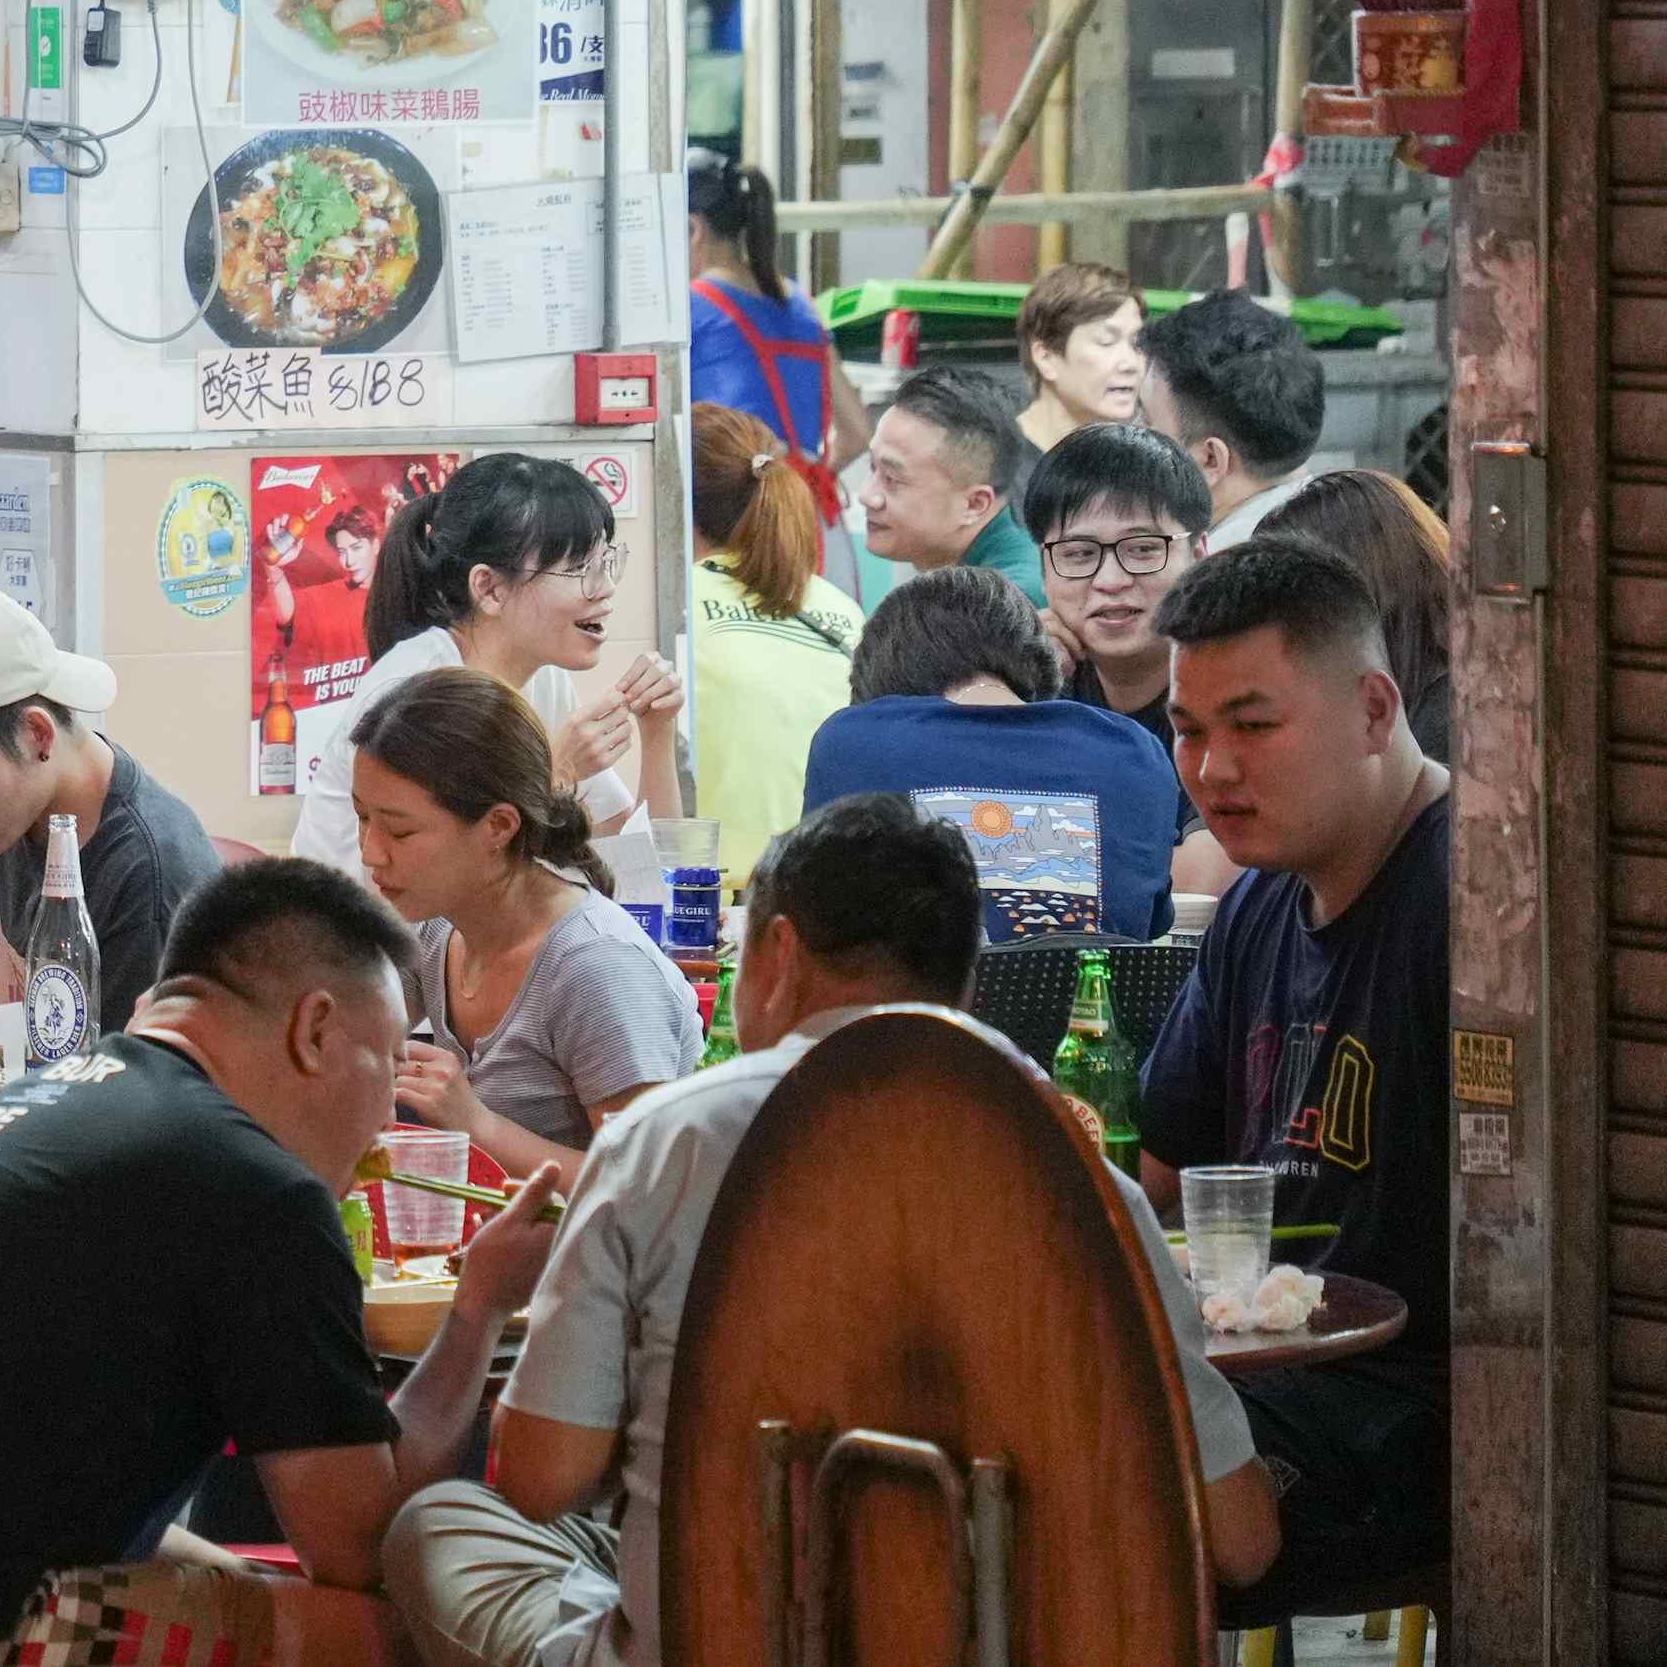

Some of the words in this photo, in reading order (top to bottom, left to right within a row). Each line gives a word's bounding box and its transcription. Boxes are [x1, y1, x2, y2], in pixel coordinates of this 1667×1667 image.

[299, 88, 481, 123] 豉椒味菜鵝腸
[202, 350, 314, 422] 酸菜魚
[304, 665, 330, 685] THE
[331, 656, 367, 681] BEAT
[315, 682, 329, 701] IS
[686, 906, 711, 916] GIRL
